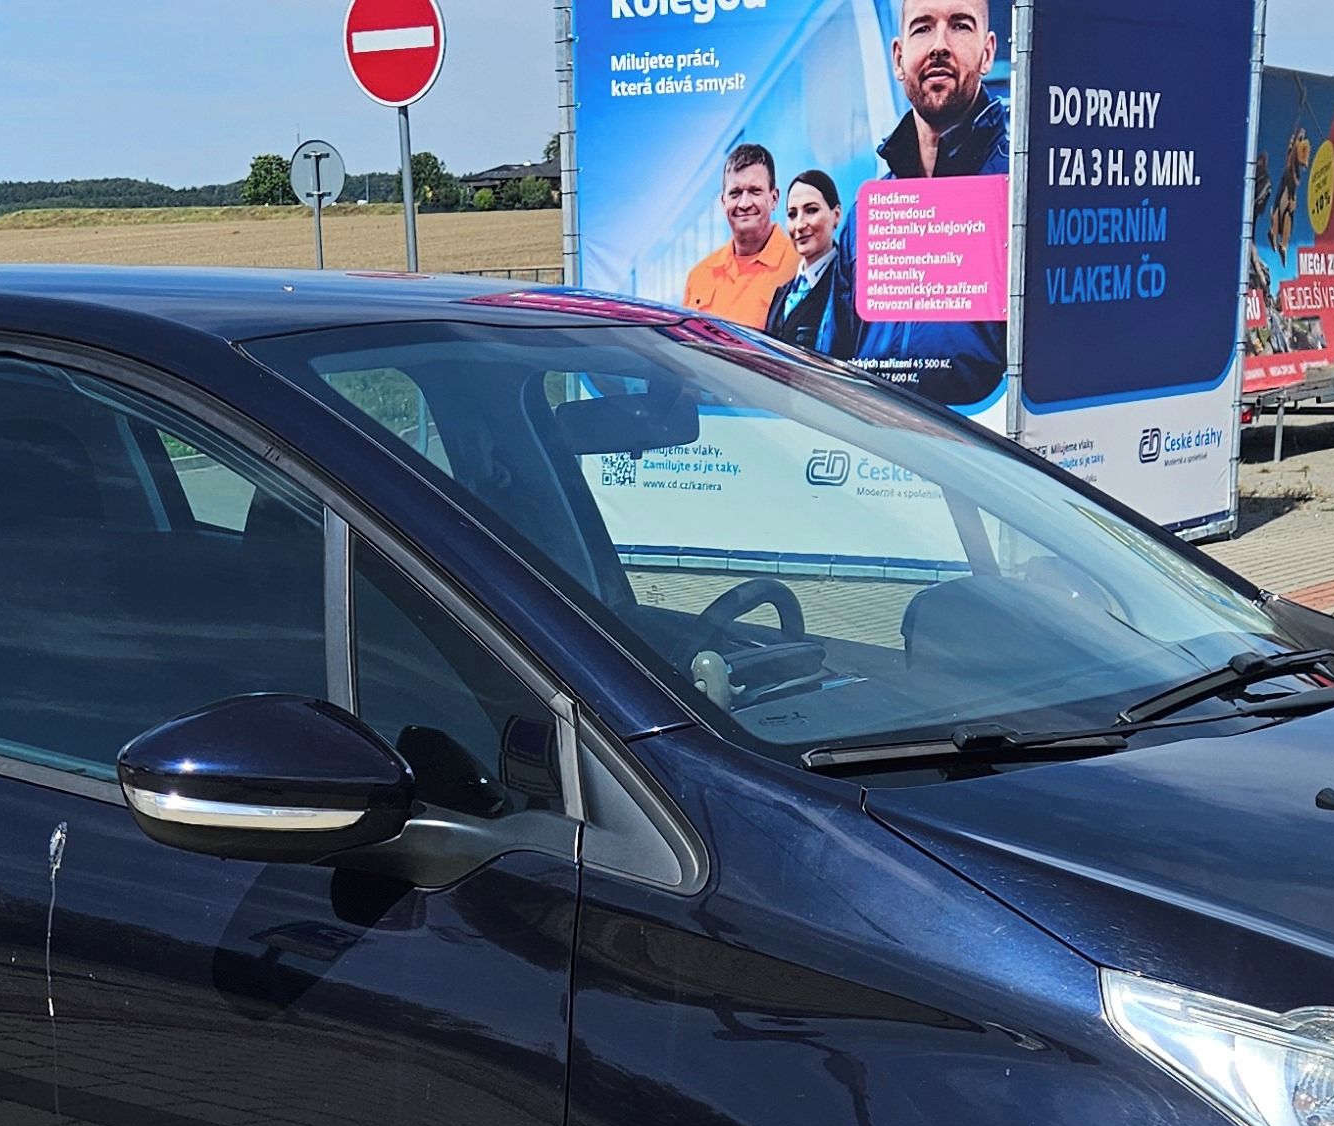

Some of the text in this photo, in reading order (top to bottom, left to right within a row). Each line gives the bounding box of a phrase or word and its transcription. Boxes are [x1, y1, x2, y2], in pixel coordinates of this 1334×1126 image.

[611, 48, 719, 74] Milujete práci,
[611, 72, 746, 97] která dává smysl?
[1049, 86, 1161, 129] DO PRAHY
[1049, 148, 1201, 187] I ZA 3 H. 8 MIN.
[869, 192, 920, 205] Hledáme:
[869, 206, 936, 221] Strojvedoucí
[869, 220, 986, 236] Mechaniky kolejových
[1048, 198, 1167, 245] MODERNÍM
[868, 239, 906, 250] vozidel
[868, 253, 963, 267] Elektromechaniky
[1299, 253, 1327, 275] MEGA
[868, 267, 925, 281] Mechaniky
[1046, 253, 1166, 305] VLAKEM ČD
[868, 282, 988, 297] elektronických zařízení
[868, 298, 972, 311] Provozní elektrikáře
[880, 358, 912, 369] zařízení
[913, 359, 923, 369] 45
[924, 359, 939, 369] 500
[891, 374, 907, 383] 600
[1165, 428, 1222, 452] České dráhy
[692, 445, 722, 458] vlaky.
[643, 460, 741, 475] Zamilujte si je taky.
